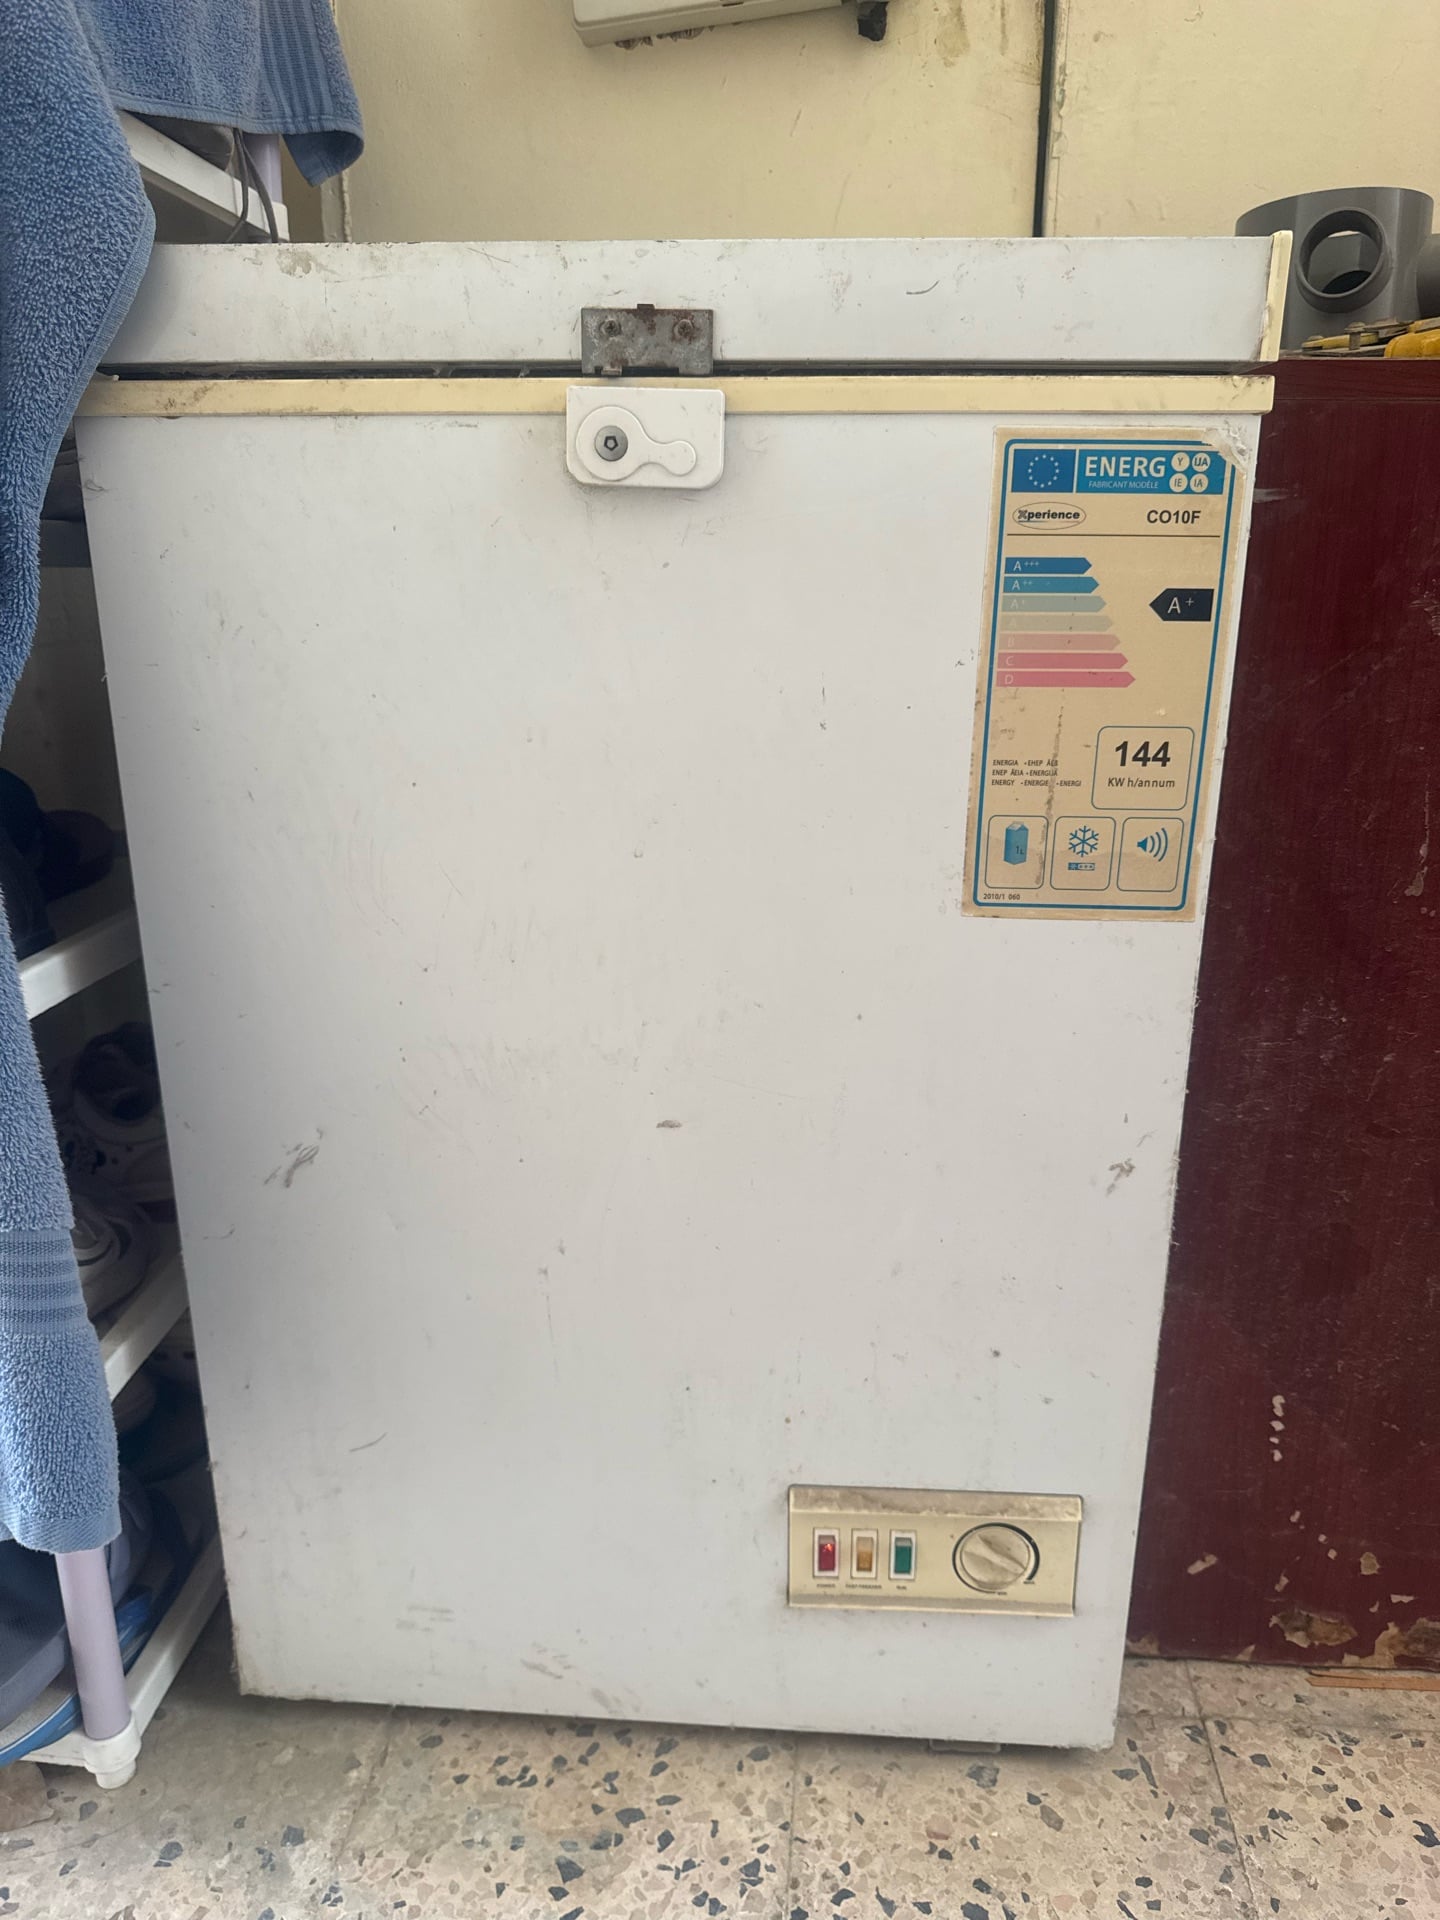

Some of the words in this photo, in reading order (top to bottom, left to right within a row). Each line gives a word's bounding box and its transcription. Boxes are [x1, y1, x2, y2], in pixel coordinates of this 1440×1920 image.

[1085, 456, 1166, 478] ENERG
[1177, 457, 1184, 466] Y
[1088, 480, 1127, 488] FABRICANT
[1174, 478, 1182, 487] IE
[1193, 478, 1203, 488] IA
[1017, 509, 1081, 521] Xperience
[1147, 510, 1201, 524] CO10F
[1167, 596, 1195, 614] A+
[1006, 655, 1014, 666] C
[1004, 674, 1014, 685] D
[1115, 740, 1171, 767] 144
[1107, 777, 1124, 787] KW
[1127, 777, 1175, 788] h/annum
